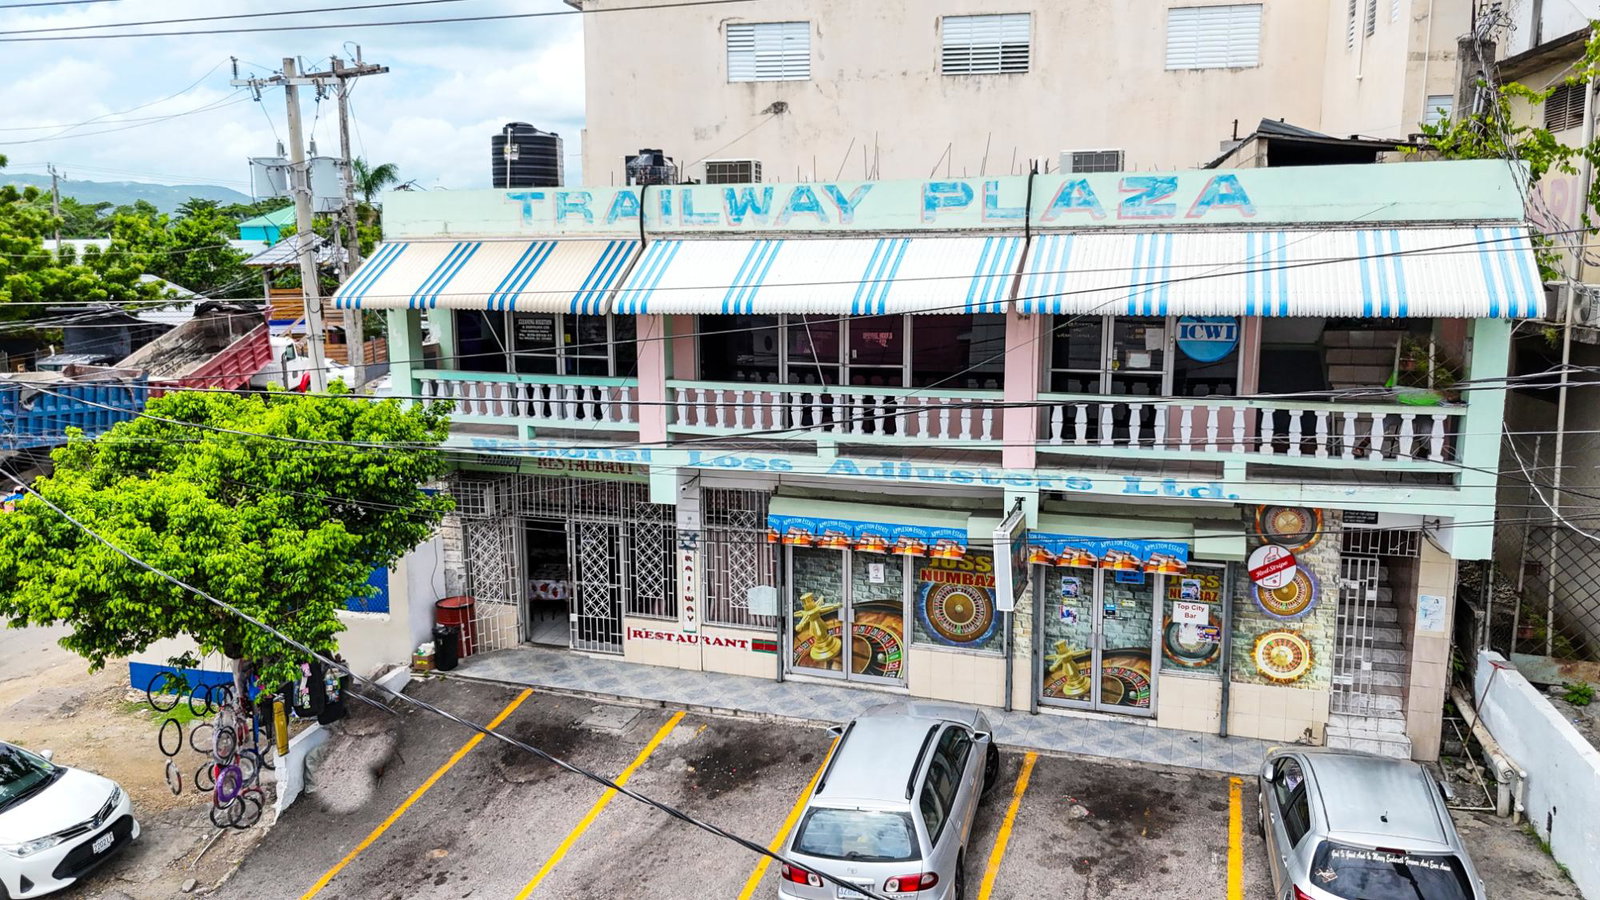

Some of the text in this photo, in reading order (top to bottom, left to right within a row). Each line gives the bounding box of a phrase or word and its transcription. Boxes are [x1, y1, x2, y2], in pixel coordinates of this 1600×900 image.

[505, 174, 1257, 226] TRAILWAY PLAZA
[1181, 325, 1235, 340] ICWI
[471, 438, 1240, 500] National Loss Adjusters Ltd.
[537, 457, 633, 474] RESTAURANT
[1177, 603, 1205, 612] Top City
[632, 629, 749, 648] RESTAURANT
